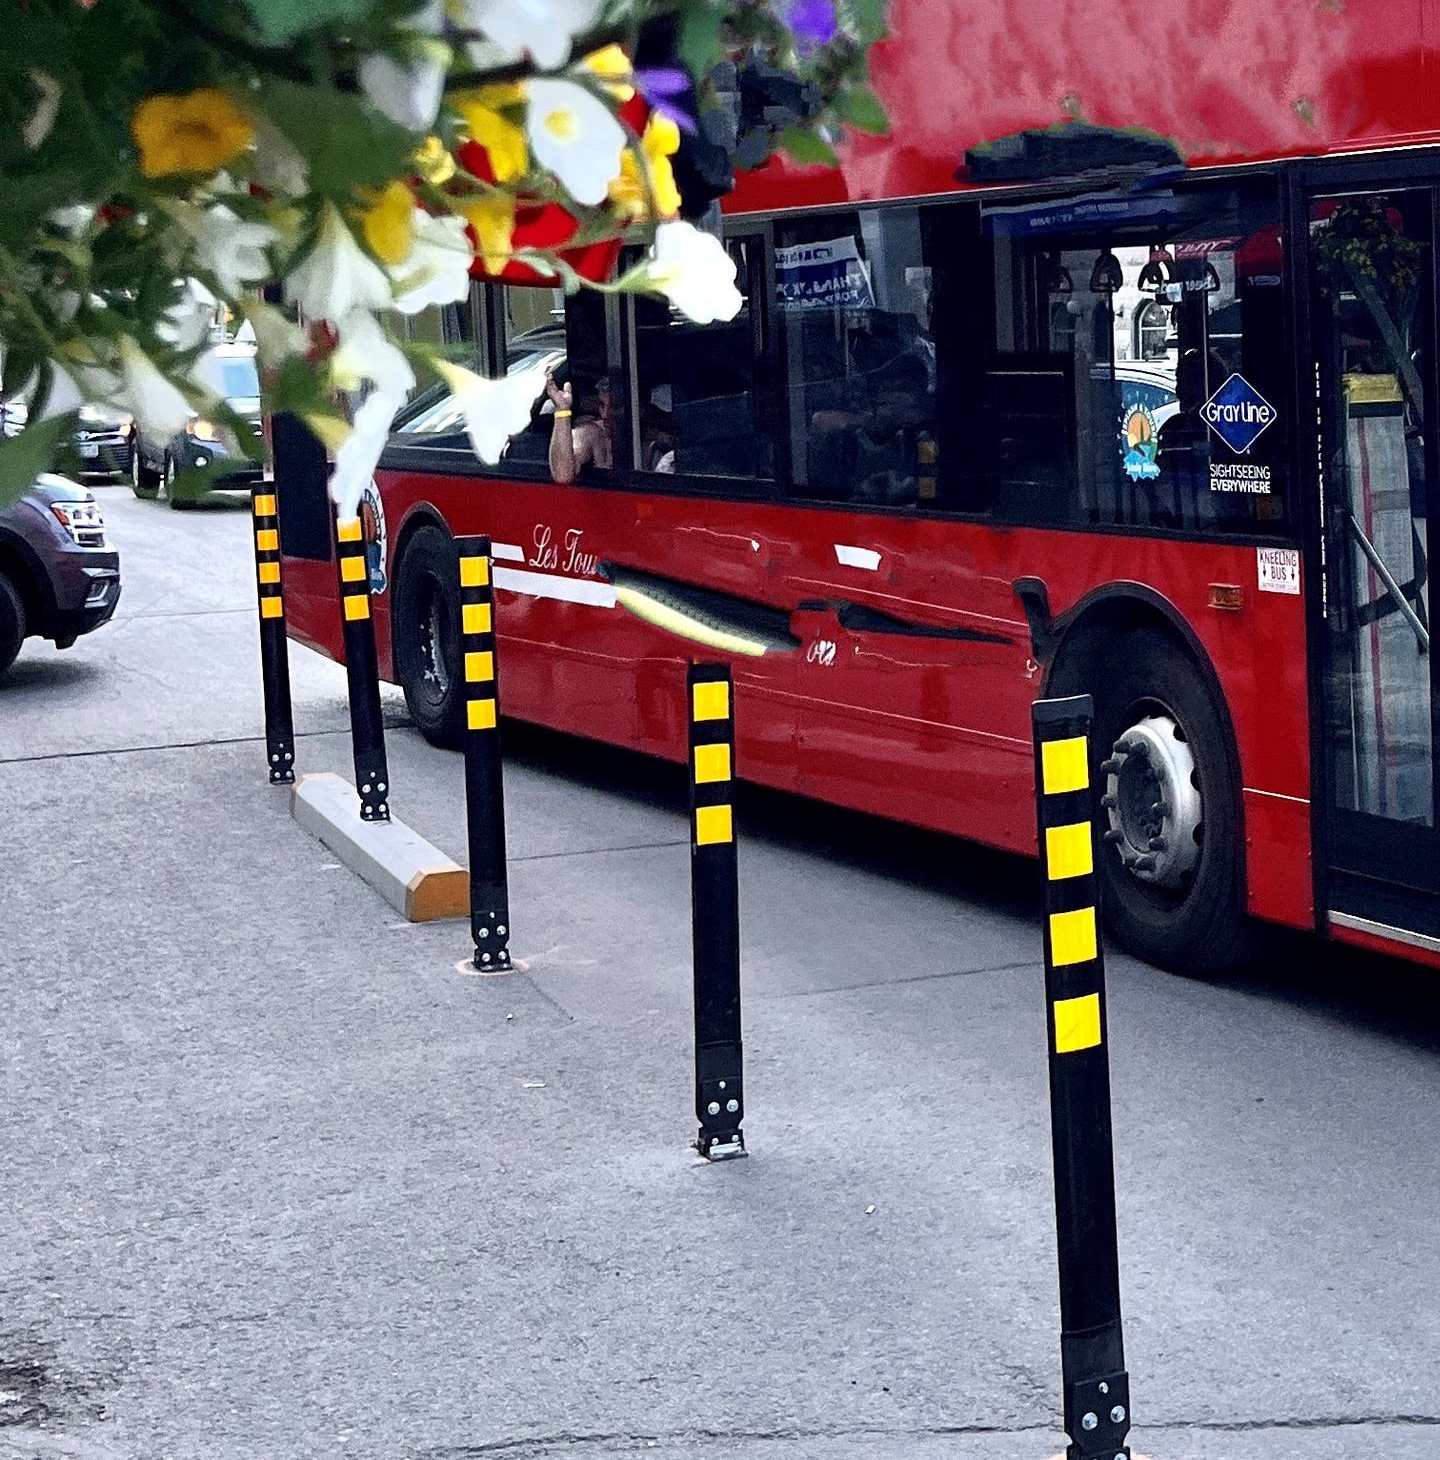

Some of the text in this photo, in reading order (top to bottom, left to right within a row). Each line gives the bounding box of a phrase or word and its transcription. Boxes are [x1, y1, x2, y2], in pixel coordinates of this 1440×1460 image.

[1209, 463, 1271, 480] SIGHTSEEING
[1210, 479, 1271, 494] EVERYWHERE
[529, 523, 559, 569] Les
[1259, 550, 1297, 567] KNEELING
[1270, 565, 1287, 581] BUS
